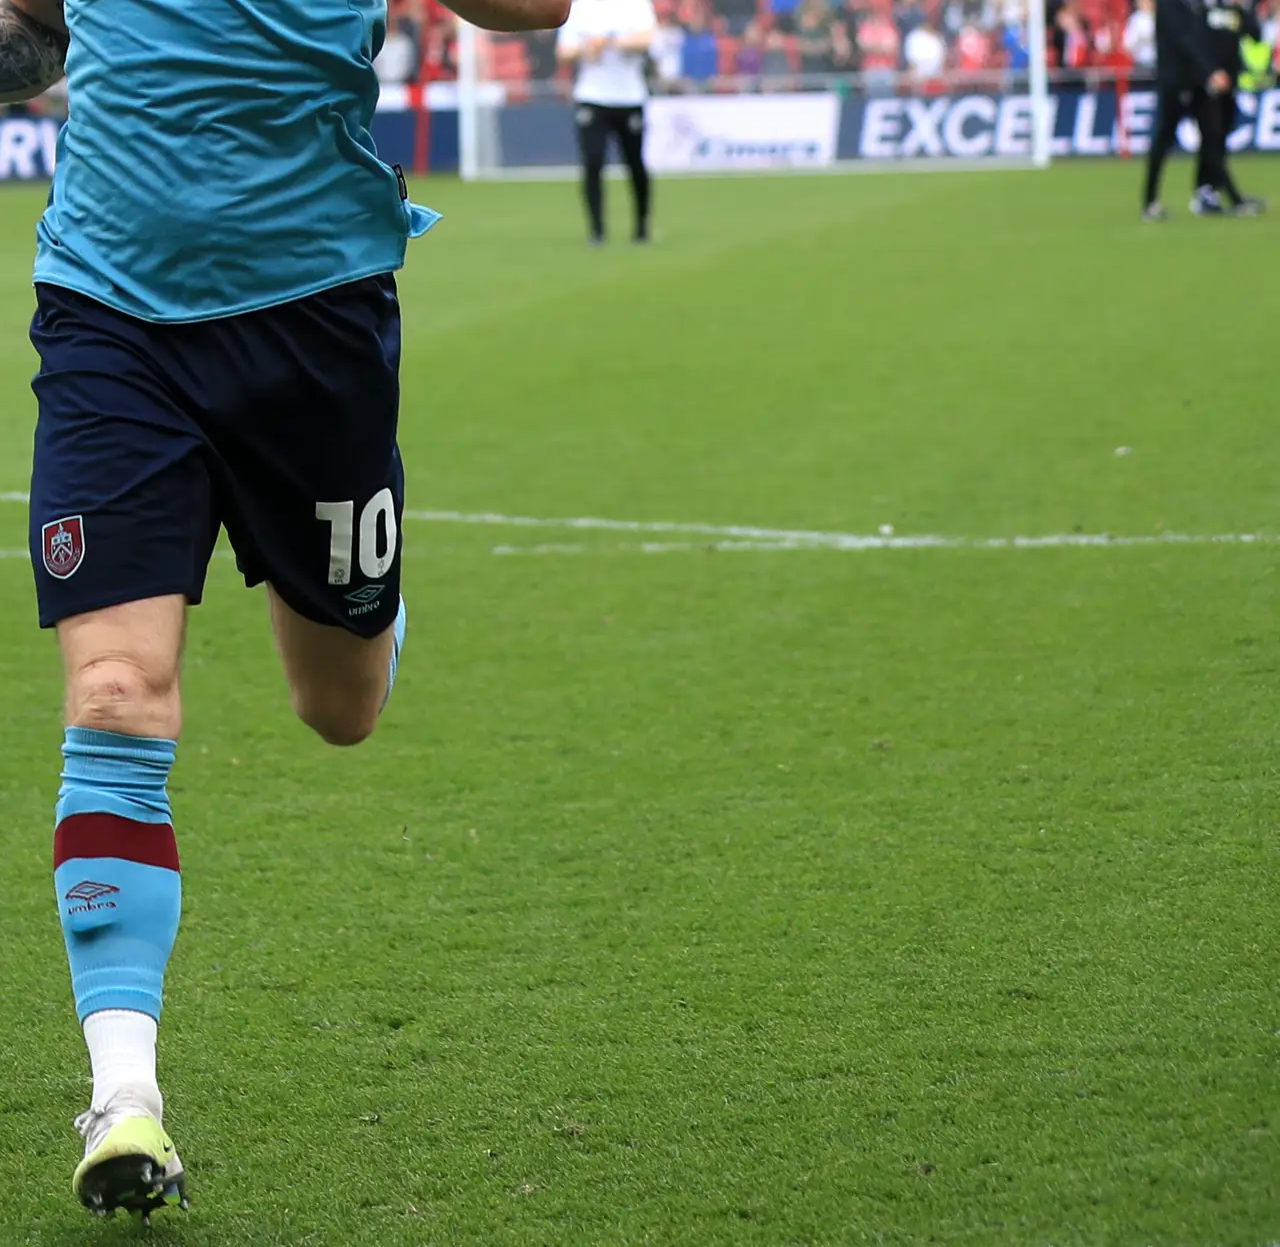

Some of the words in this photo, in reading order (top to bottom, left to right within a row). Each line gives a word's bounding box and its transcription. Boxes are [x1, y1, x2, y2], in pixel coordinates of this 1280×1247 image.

[315, 487, 397, 585] 10
[349, 600, 380, 616] umbro
[68, 900, 116, 915] umbro
